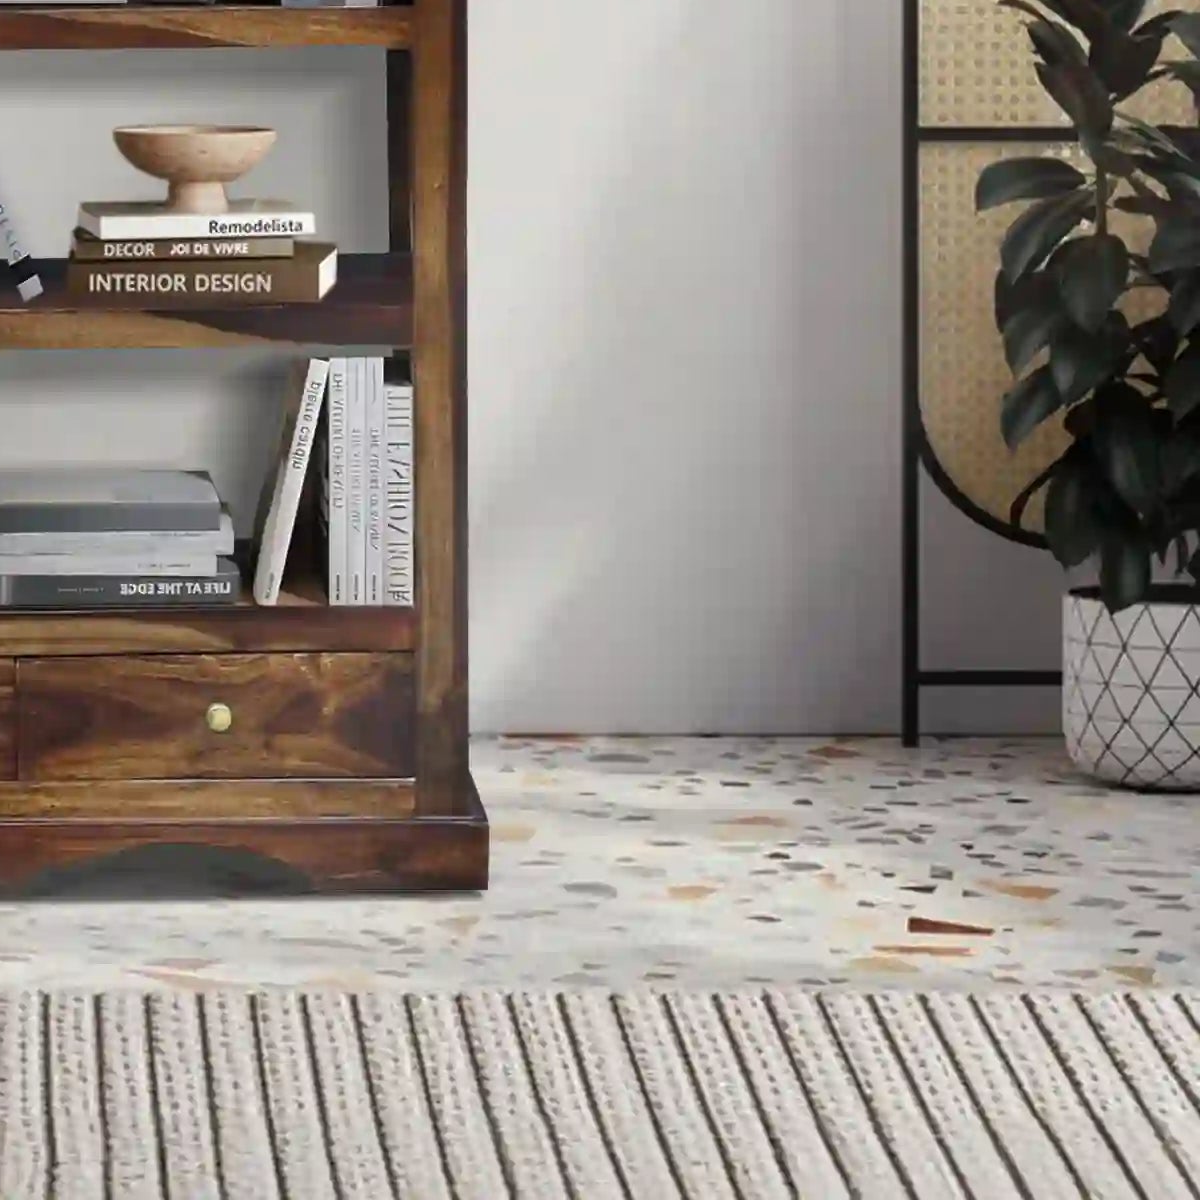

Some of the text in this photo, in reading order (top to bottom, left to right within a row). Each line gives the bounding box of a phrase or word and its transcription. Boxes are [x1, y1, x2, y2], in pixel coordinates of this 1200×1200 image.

[208, 219, 304, 234] Remodelista
[104, 243, 155, 257] DECOR
[89, 273, 272, 293] INTERIOR DESIGN
